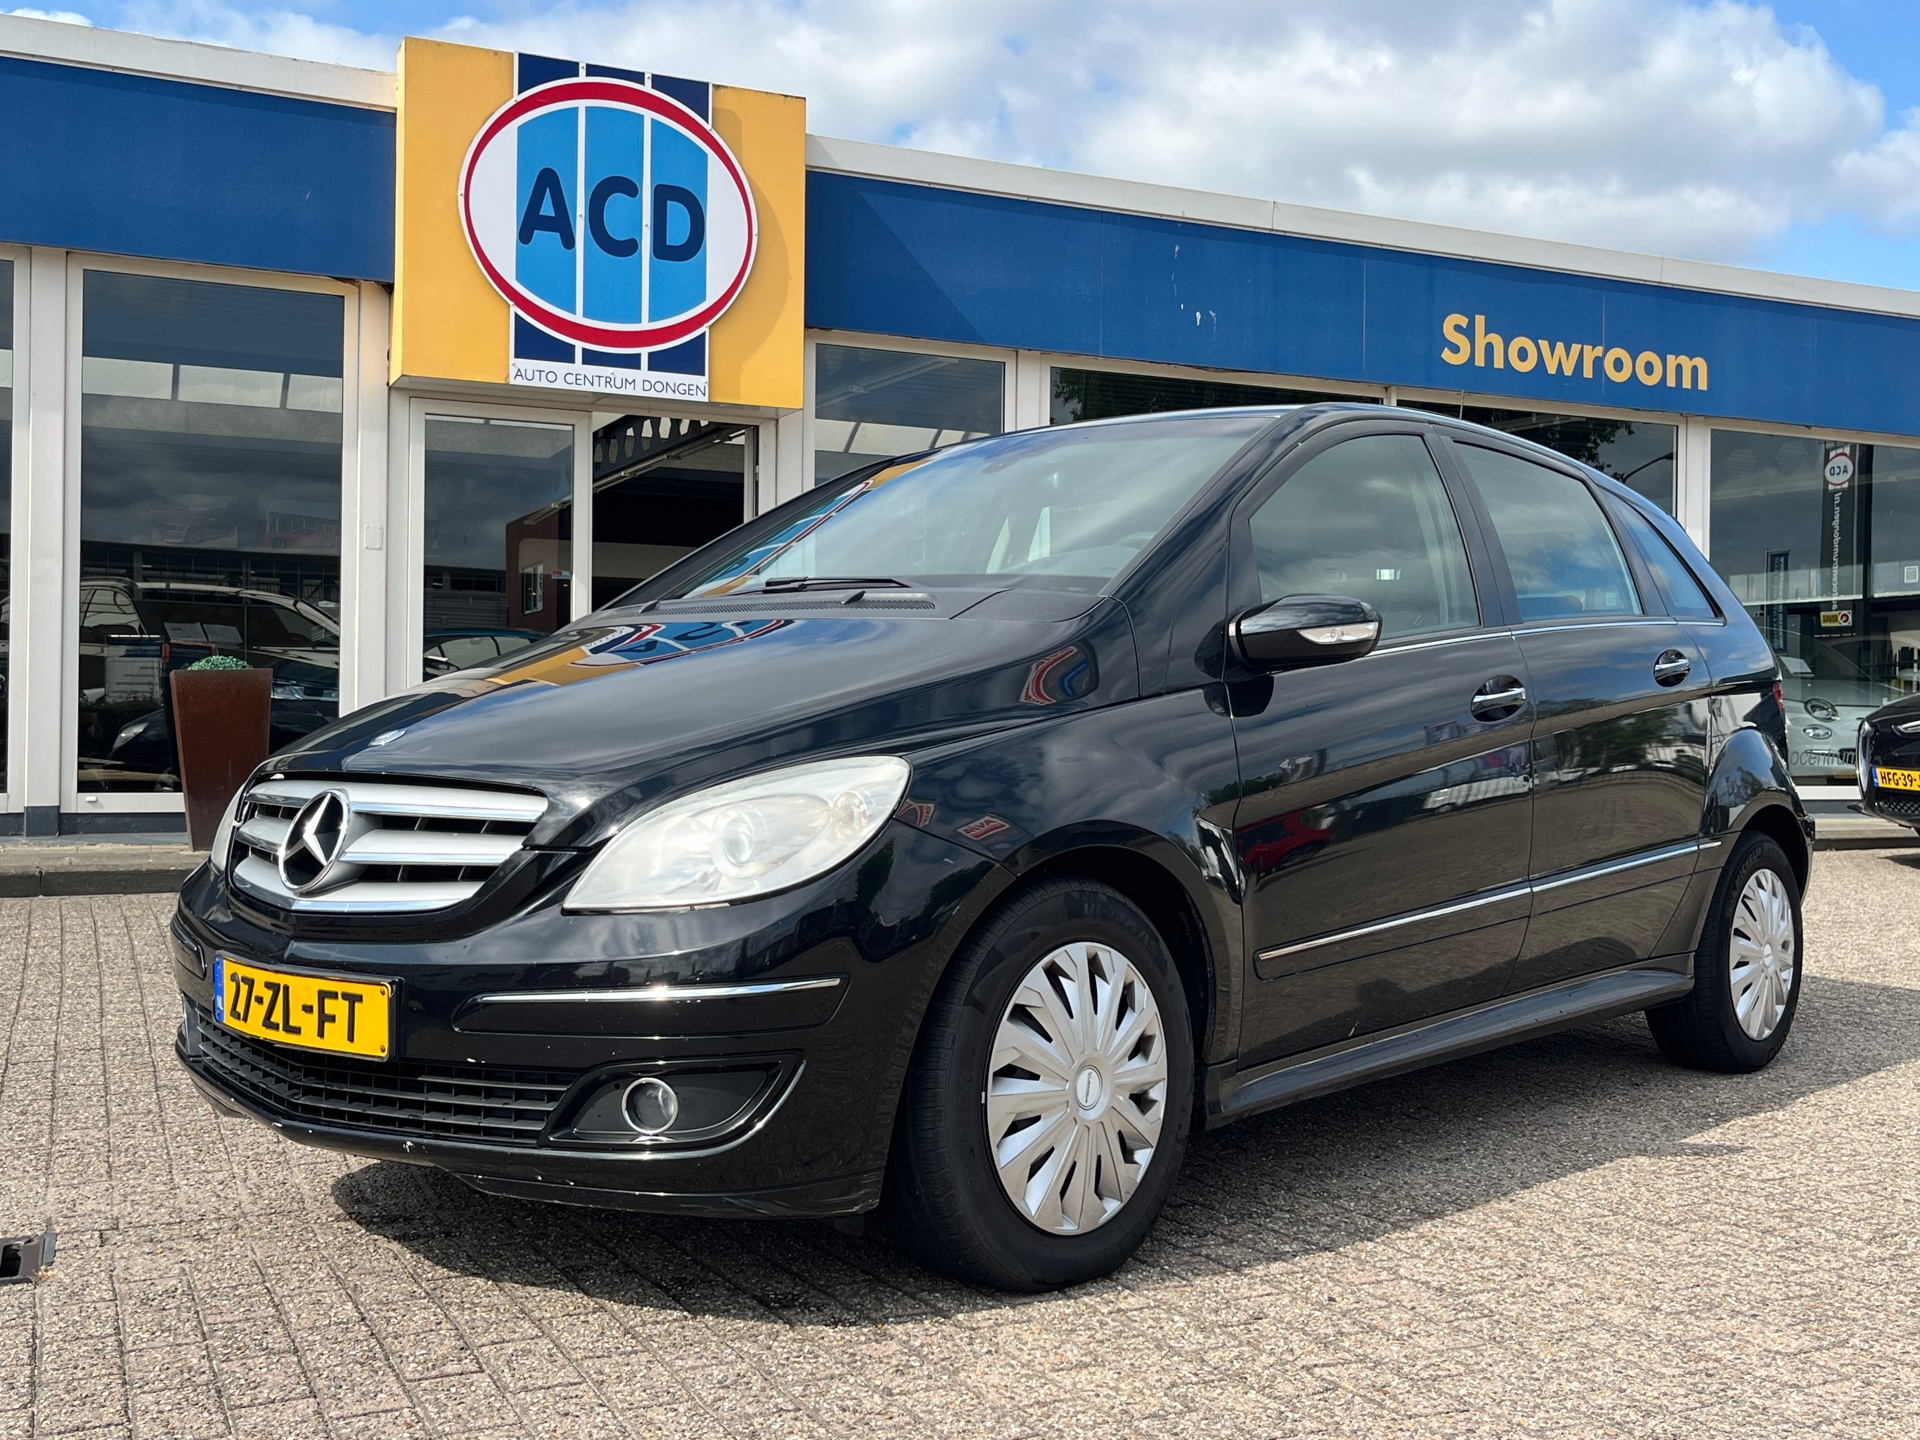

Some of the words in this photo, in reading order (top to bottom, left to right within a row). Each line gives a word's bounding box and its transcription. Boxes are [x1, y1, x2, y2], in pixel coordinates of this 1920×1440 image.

[519, 167, 705, 262] ACD
[514, 368, 557, 383] AUTO
[564, 372, 636, 391] CENTRUM
[642, 379, 706, 397] DONGEN
[1441, 313, 1708, 391] Showroom
[229, 972, 364, 1043] 27-ZL-FT
